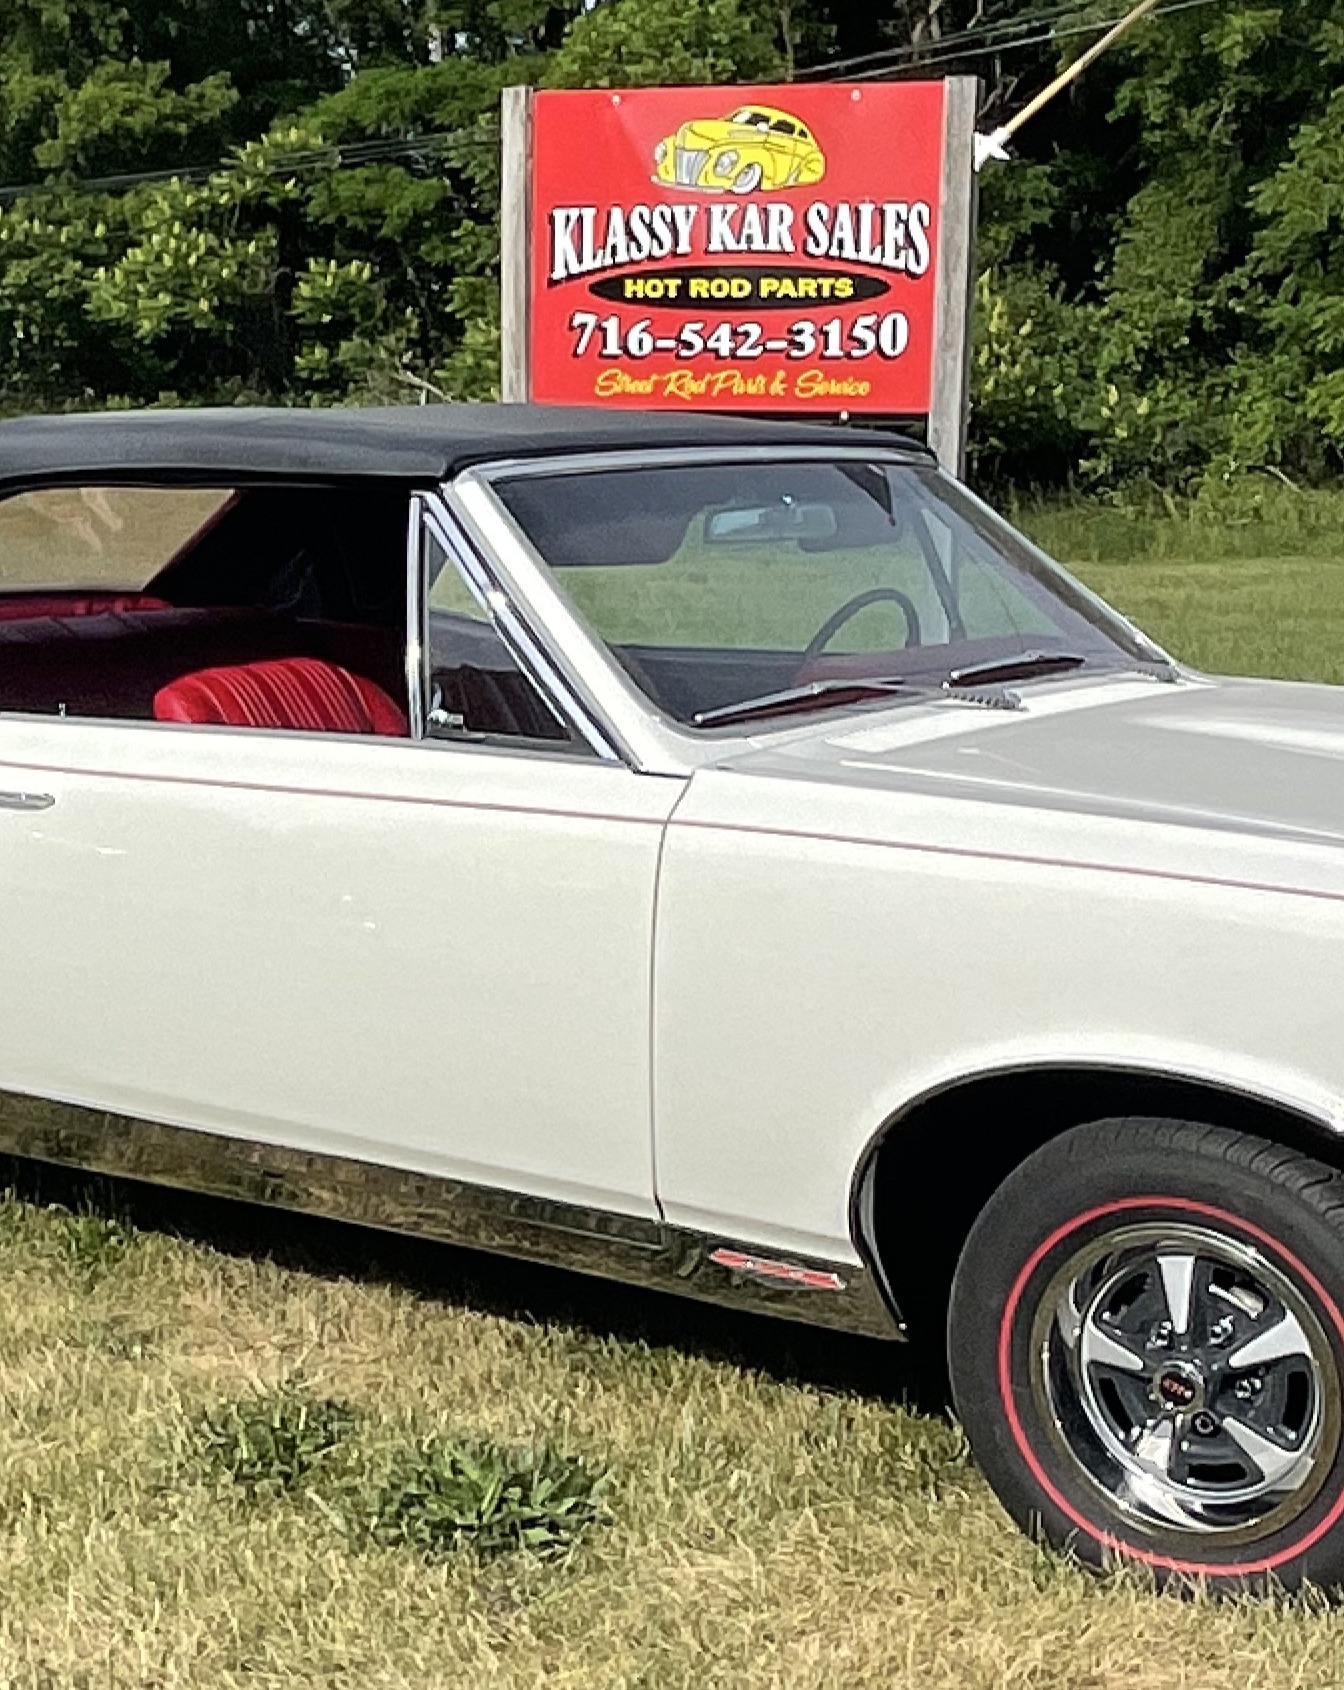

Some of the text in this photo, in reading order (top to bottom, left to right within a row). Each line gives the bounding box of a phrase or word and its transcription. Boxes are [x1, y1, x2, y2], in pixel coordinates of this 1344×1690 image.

[550, 201, 931, 280] KLASSY KAR SALES
[624, 277, 854, 298] HOT ROD PARTS
[571, 311, 909, 357] 716-542-3150
[595, 368, 871, 400] Street Rod Parts & Service
